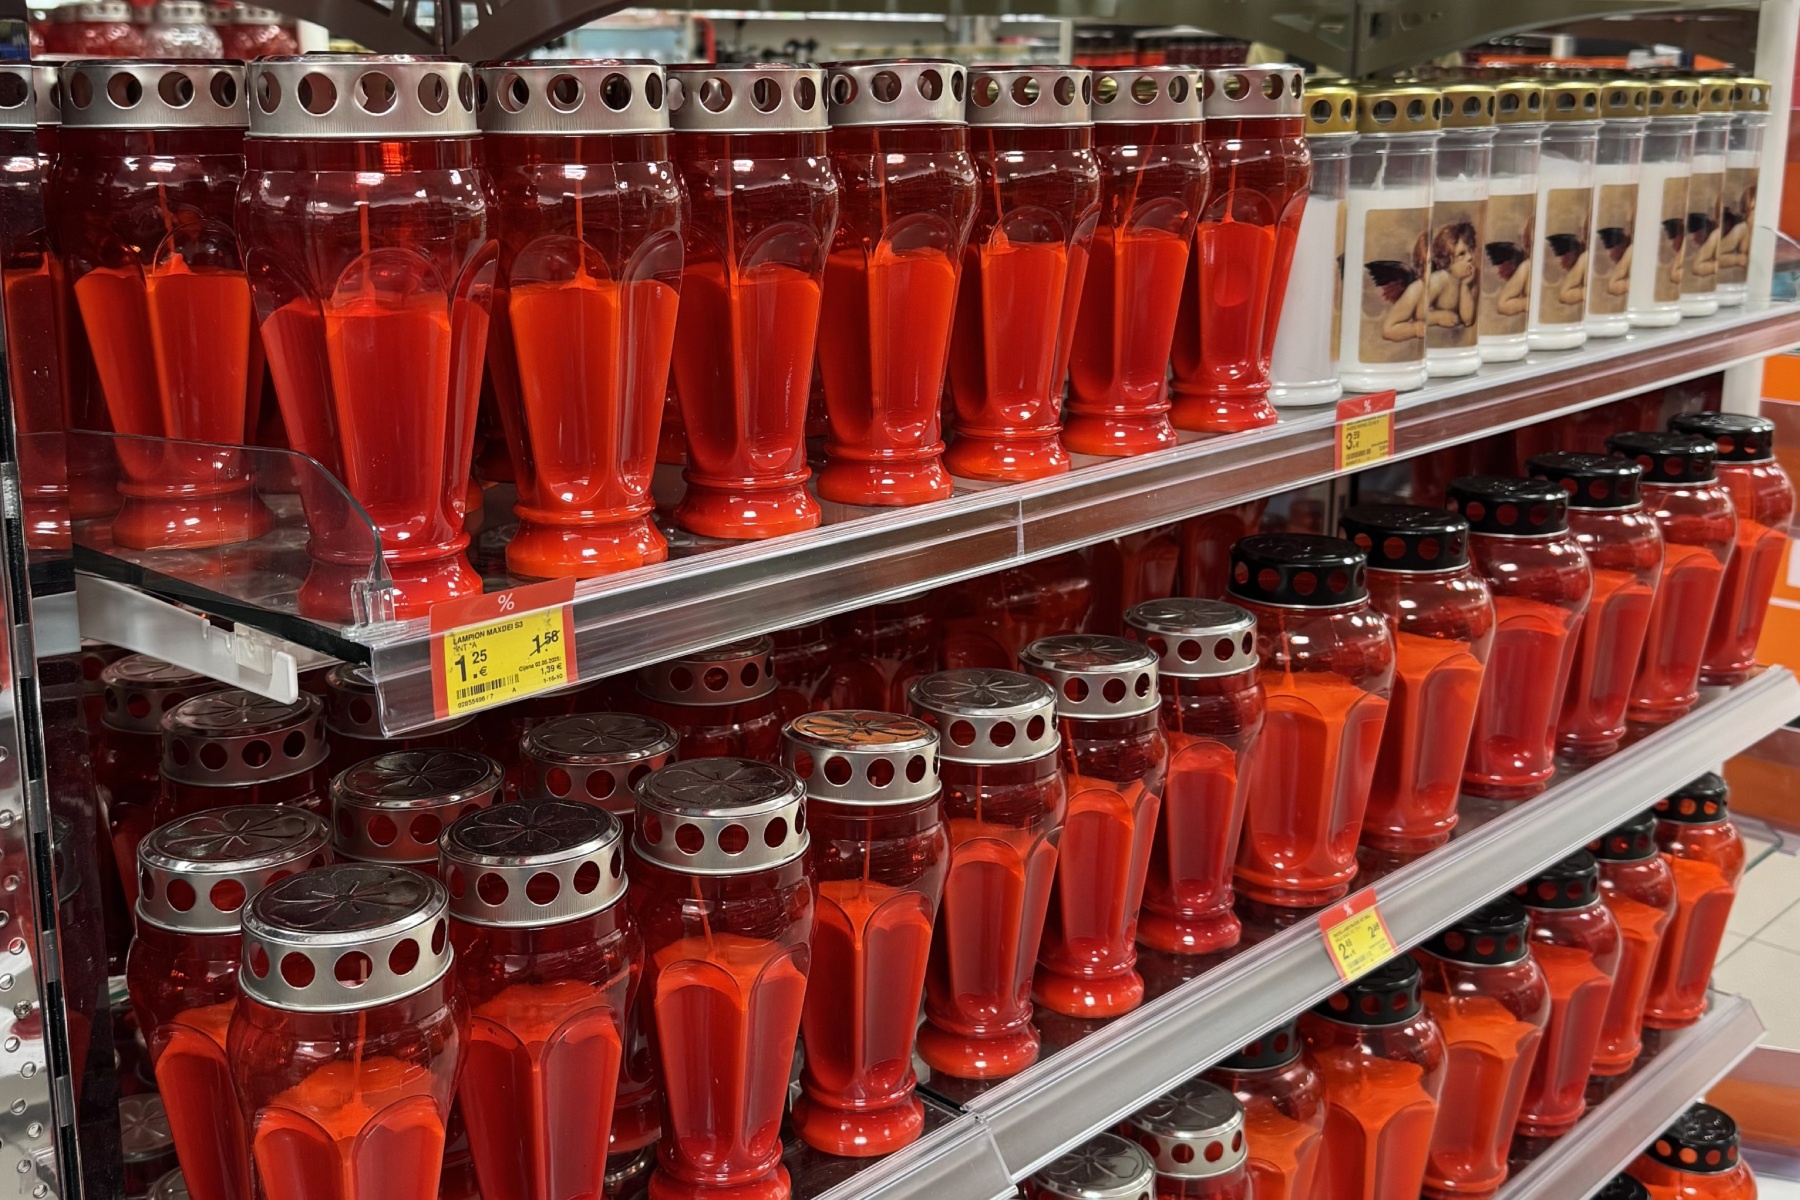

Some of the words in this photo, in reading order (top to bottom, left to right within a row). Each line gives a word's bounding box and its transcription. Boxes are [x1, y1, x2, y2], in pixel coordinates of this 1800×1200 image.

[453, 631, 485, 645] LAMPION
[514, 620, 524, 629] S3
[519, 663, 534, 672] Cijena
[541, 664, 555, 676] 1,39
